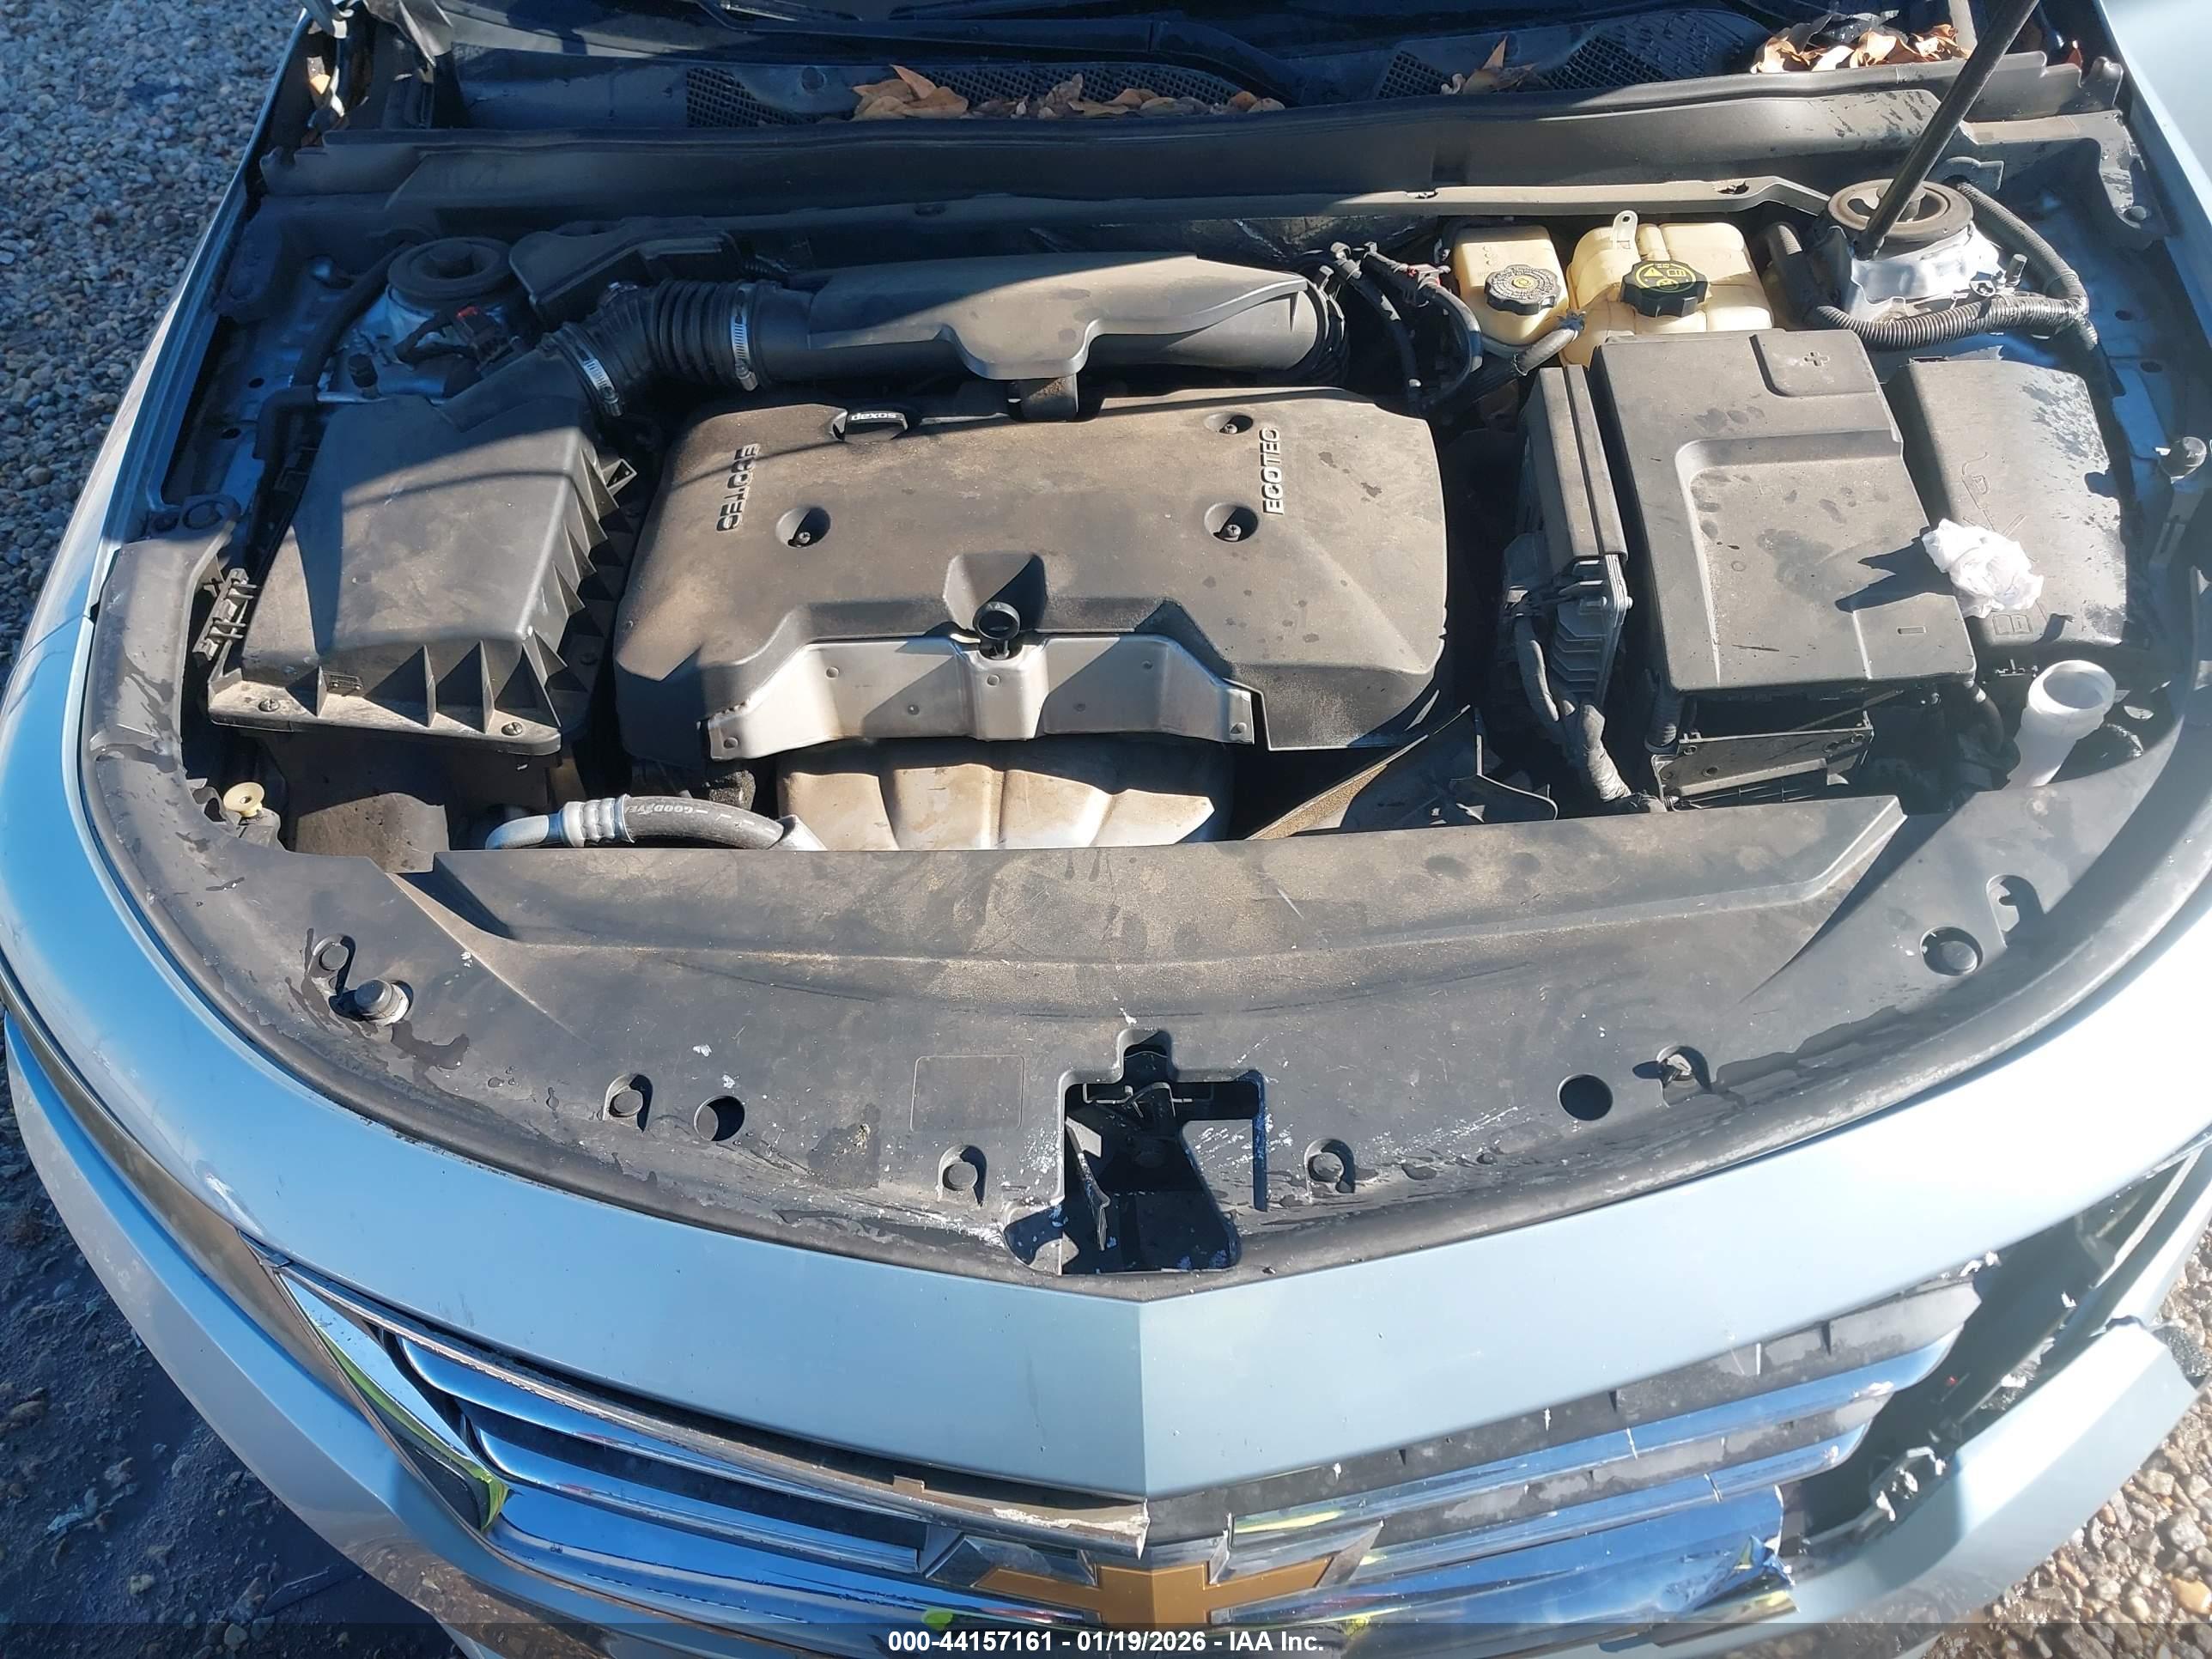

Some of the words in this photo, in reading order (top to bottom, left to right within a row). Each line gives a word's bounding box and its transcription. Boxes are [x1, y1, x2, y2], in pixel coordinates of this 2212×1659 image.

[851, 412, 896, 421] dexos
[716, 444, 760, 532] ECOTEC
[1259, 428, 1284, 515] ECOTEC
